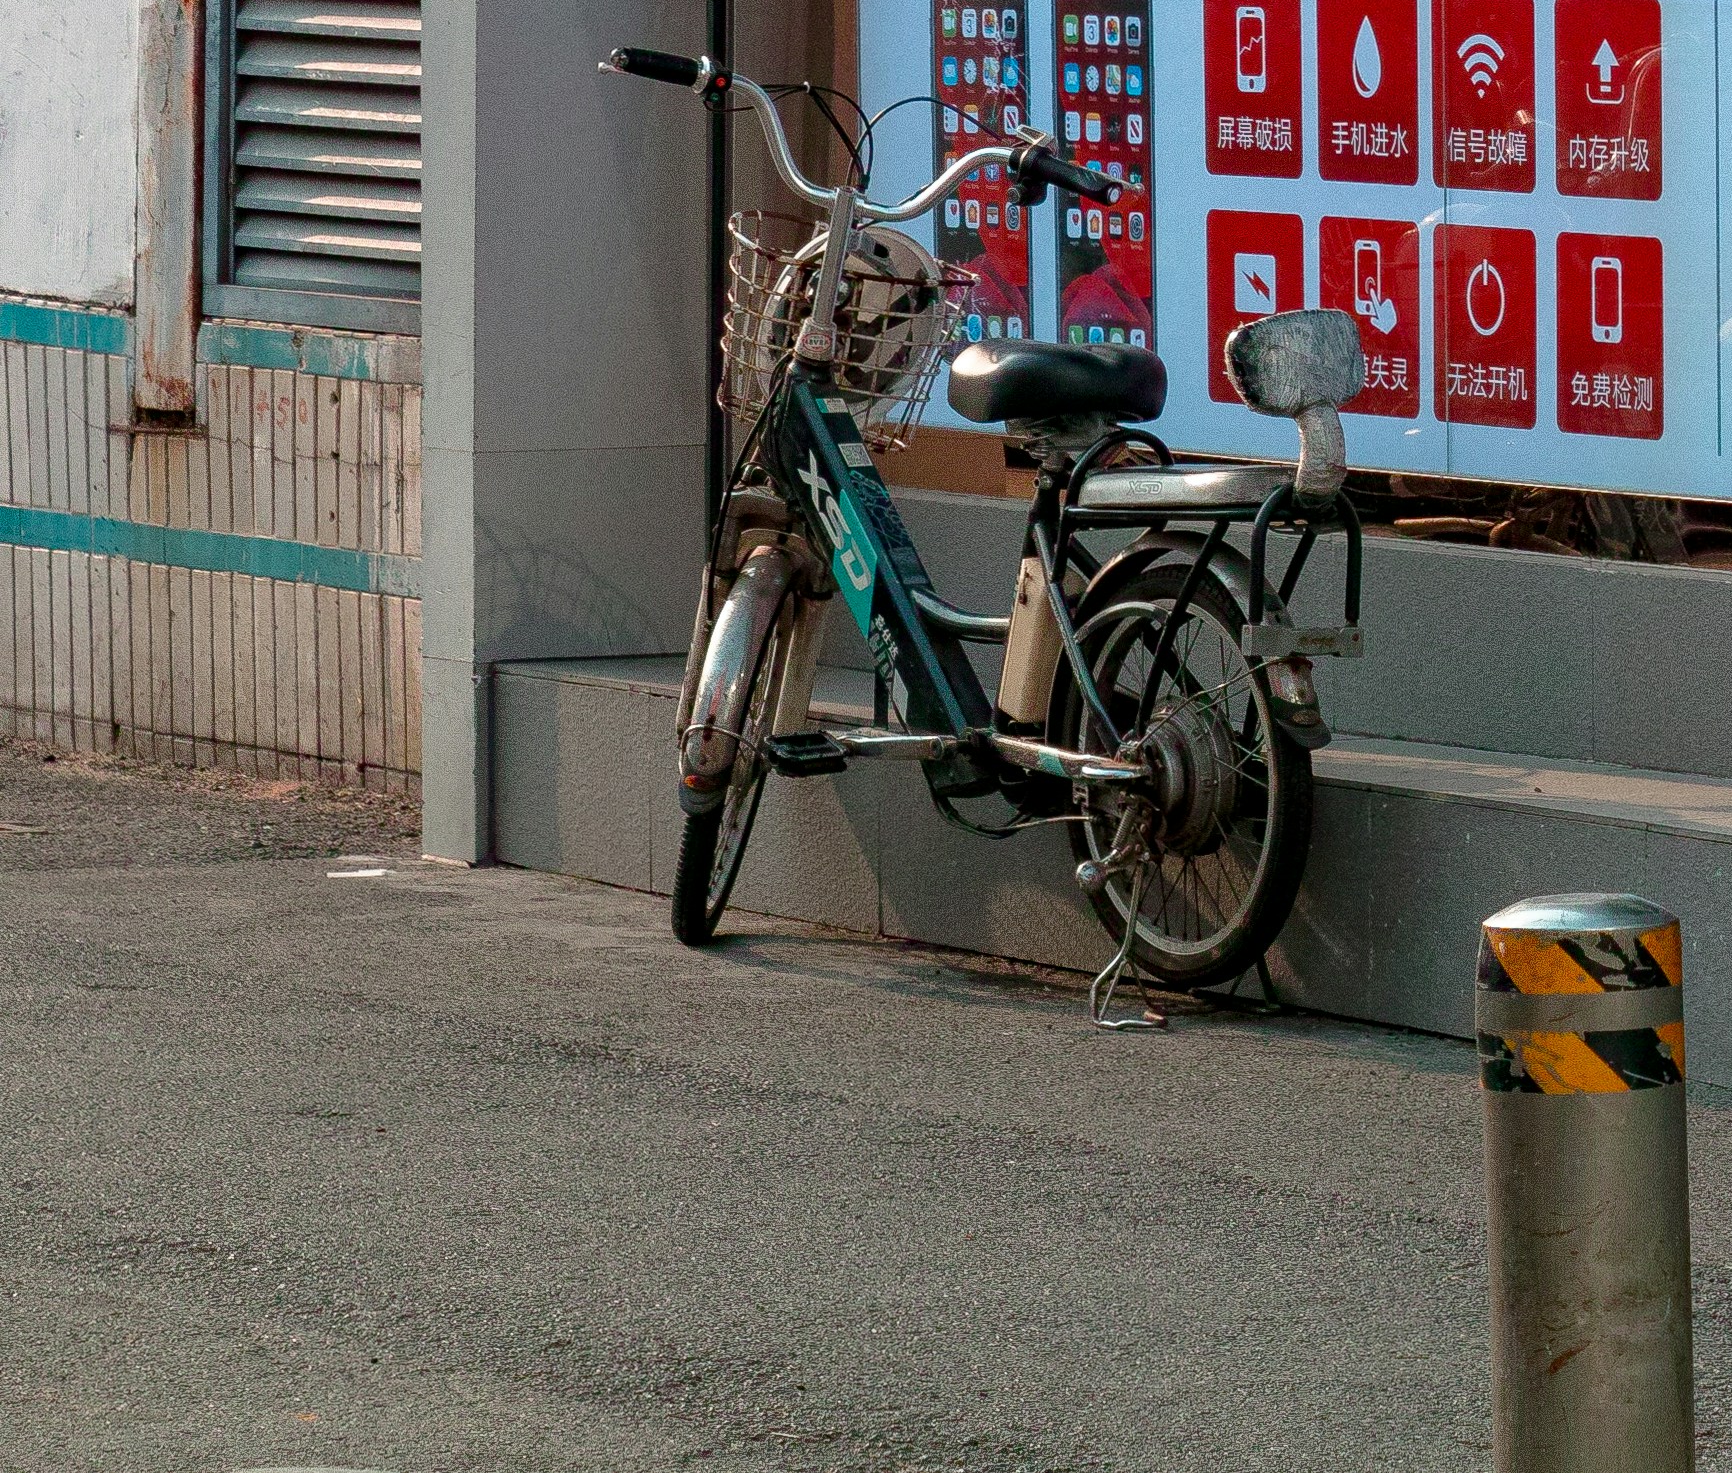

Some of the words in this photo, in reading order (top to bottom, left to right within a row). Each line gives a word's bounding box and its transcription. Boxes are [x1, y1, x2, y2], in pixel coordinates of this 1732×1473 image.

[1216, 114, 1294, 153] 屏幕破损
[1330, 120, 1409, 158] 手机进水
[1446, 125, 1529, 169] 信号故障
[1568, 134, 1652, 174] 内存升级
[1446, 364, 1529, 404] 无法开机
[1570, 372, 1655, 412] 免费检测
[1128, 480, 1164, 495] XSD
[797, 448, 872, 592] XSD
